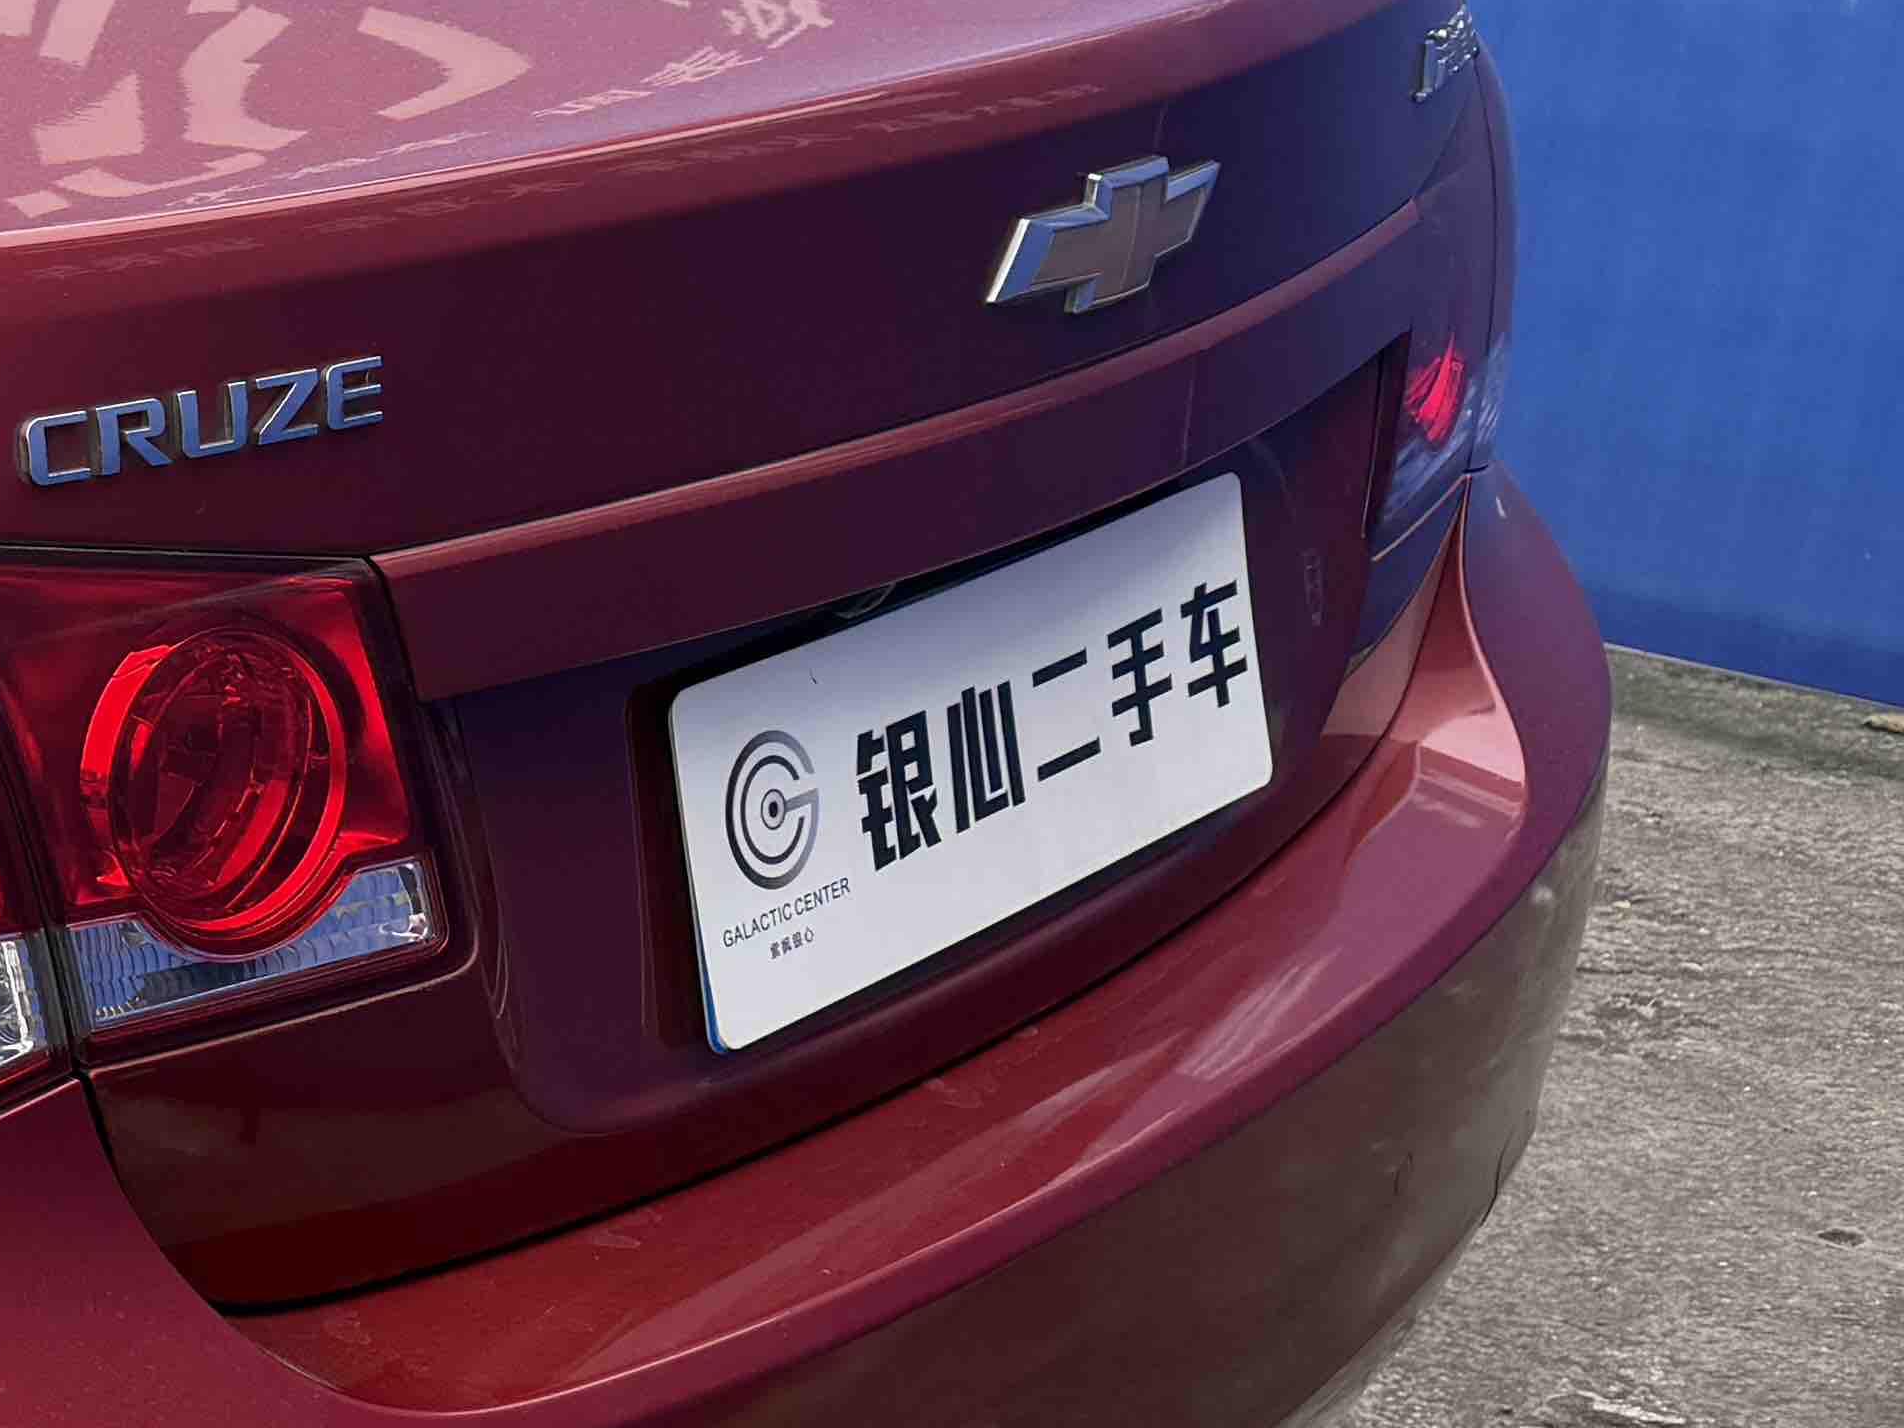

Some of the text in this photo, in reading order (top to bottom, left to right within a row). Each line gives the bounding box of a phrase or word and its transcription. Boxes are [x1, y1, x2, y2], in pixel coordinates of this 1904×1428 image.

[18, 354, 385, 488] CRUZE
[853, 579, 1249, 872] 银心二手车
[721, 876, 851, 948] GALACTIC CENTER
